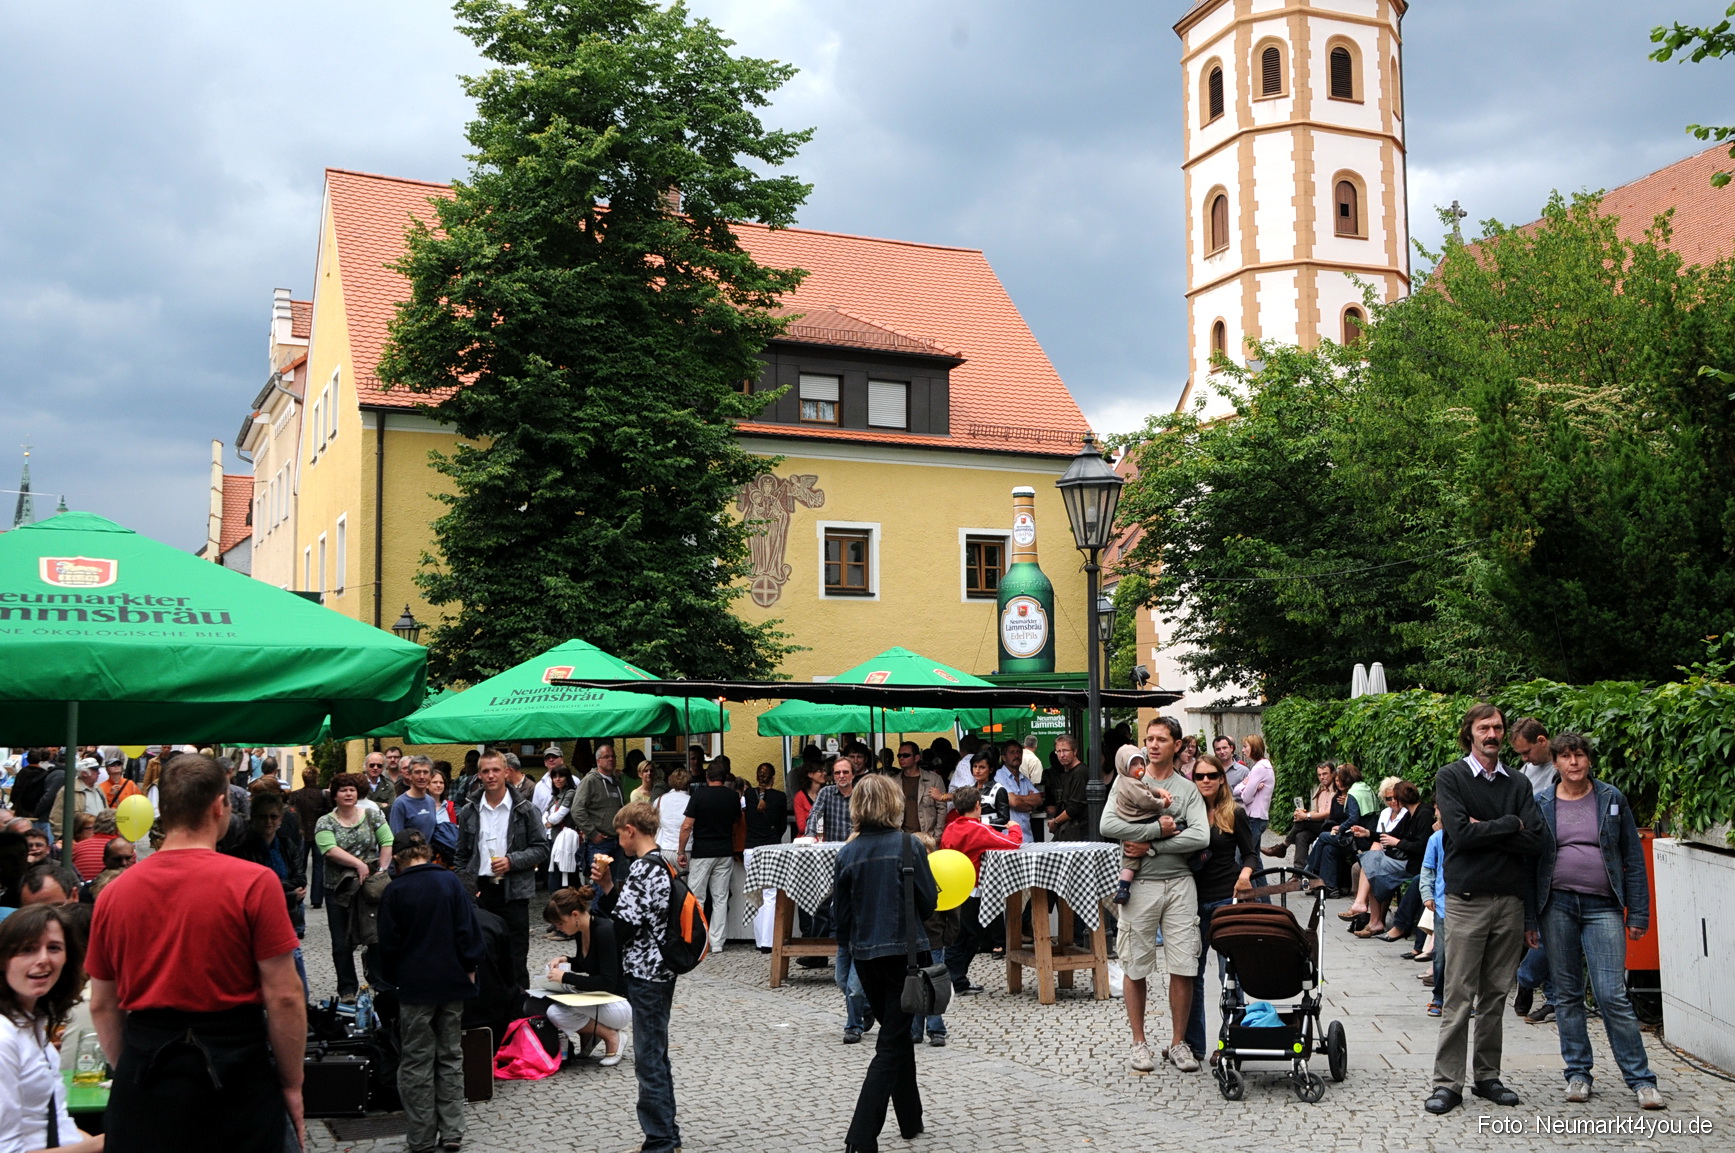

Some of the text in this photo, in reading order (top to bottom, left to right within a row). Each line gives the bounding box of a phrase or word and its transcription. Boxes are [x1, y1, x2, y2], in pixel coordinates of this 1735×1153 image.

[0, 592, 191, 607] eumarkter
[0, 606, 233, 625] mmsbräu
[32, 628, 188, 637] ÖKOLOGISCHE
[1006, 623, 1042, 631] Lammsbräu
[489, 692, 605, 706] Lammsbräu
